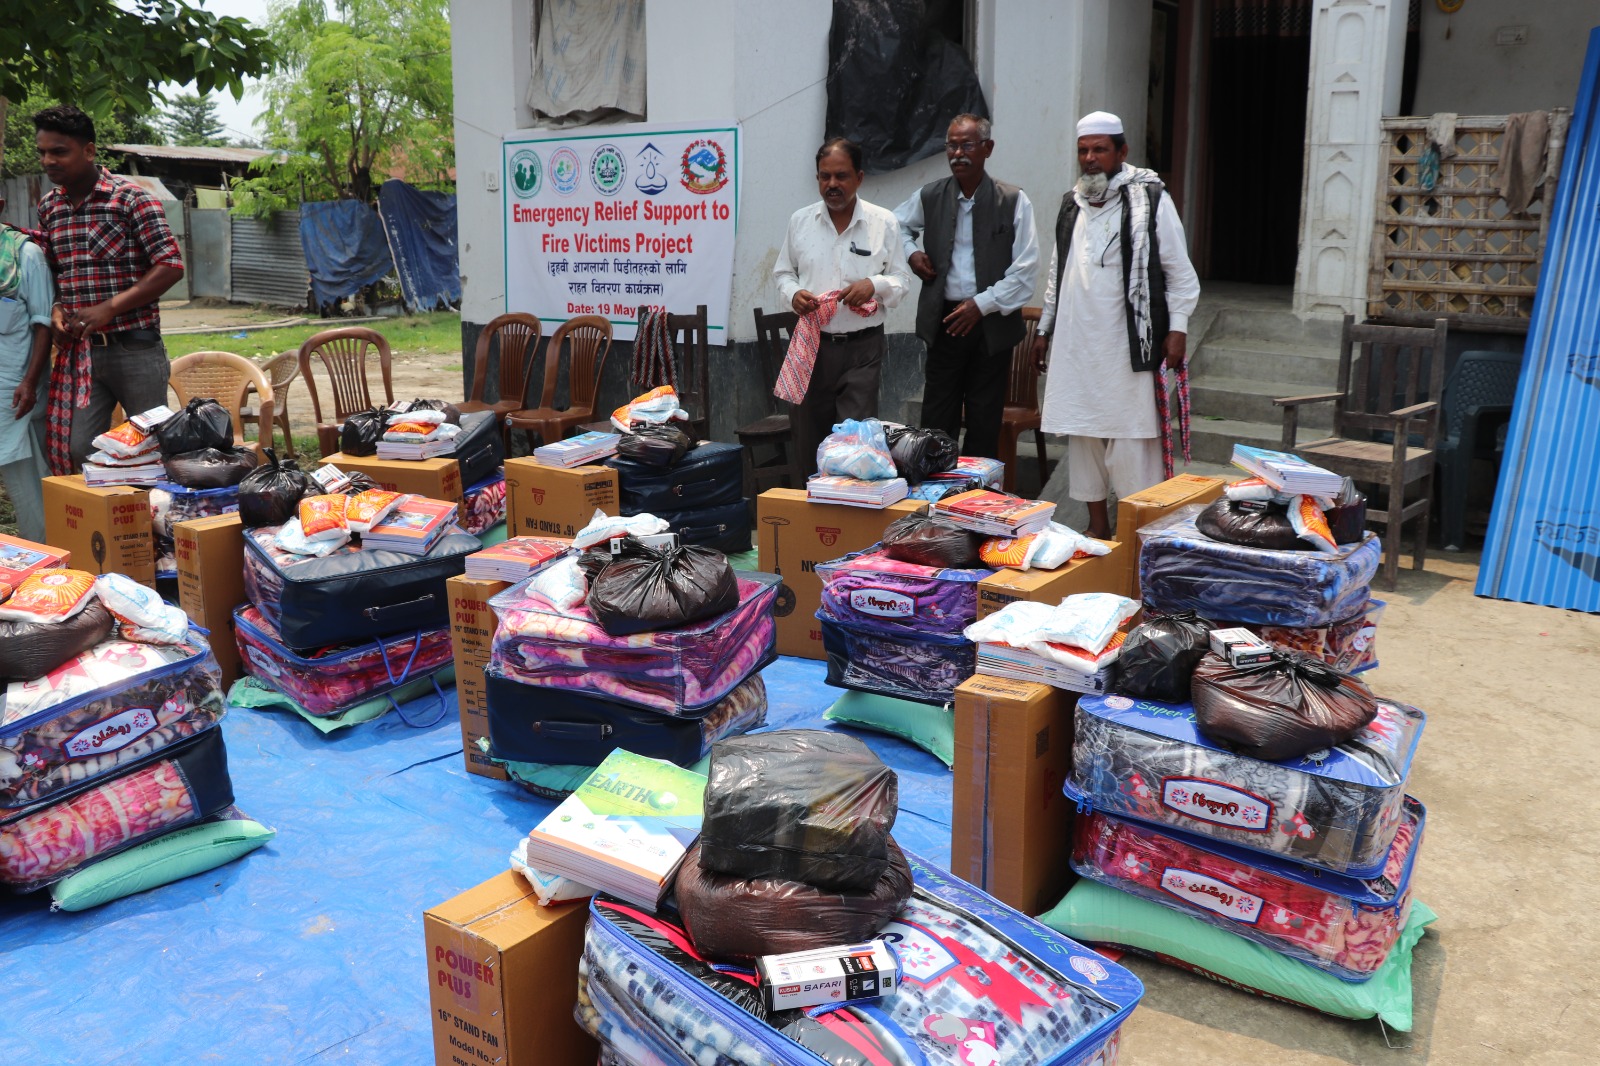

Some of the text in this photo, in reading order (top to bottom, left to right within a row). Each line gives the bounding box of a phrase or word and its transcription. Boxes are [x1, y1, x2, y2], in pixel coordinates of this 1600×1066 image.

[513, 199, 730, 227] Emergency Relief Support to
[542, 232, 693, 258] Fire Victims Project
[573, 258, 610, 275] आगलागी
[665, 258, 688, 275] लागि
[568, 281, 587, 295] राहत
[591, 279, 621, 295] वितरण
[567, 302, 594, 314] Date:
[597, 303, 610, 315] 19
[614, 304, 636, 318] May
[65, 504, 83, 519] POWER
[112, 502, 147, 515] POWER
[66, 517, 78, 530] PLUS
[113, 514, 134, 526] PLUS
[525, 516, 537, 530] FAN
[539, 517, 561, 535] STAND
[176, 537, 197, 551] POWER
[178, 549, 191, 561] PLUS
[454, 597, 488, 613] POWER
[455, 612, 476, 625] PLUS
[463, 626, 479, 637] STAND
[479, 628, 489, 637] FAN
[1136, 701, 1185, 719] Super
[91, 722, 132, 748] روشان
[586, 772, 650, 804] EARTH
[1191, 790, 1241, 818] روشان
[1189, 882, 1234, 906] روشان
[1014, 919, 1069, 955] Super
[435, 945, 495, 987] POWER
[1002, 950, 1070, 1000] ALSILK
[437, 969, 472, 999] PLUS
[778, 980, 843, 996] KUSUM SAFARI
[438, 1008, 499, 1048] 16" STAND FAN
[449, 1034, 475, 1056] Model
